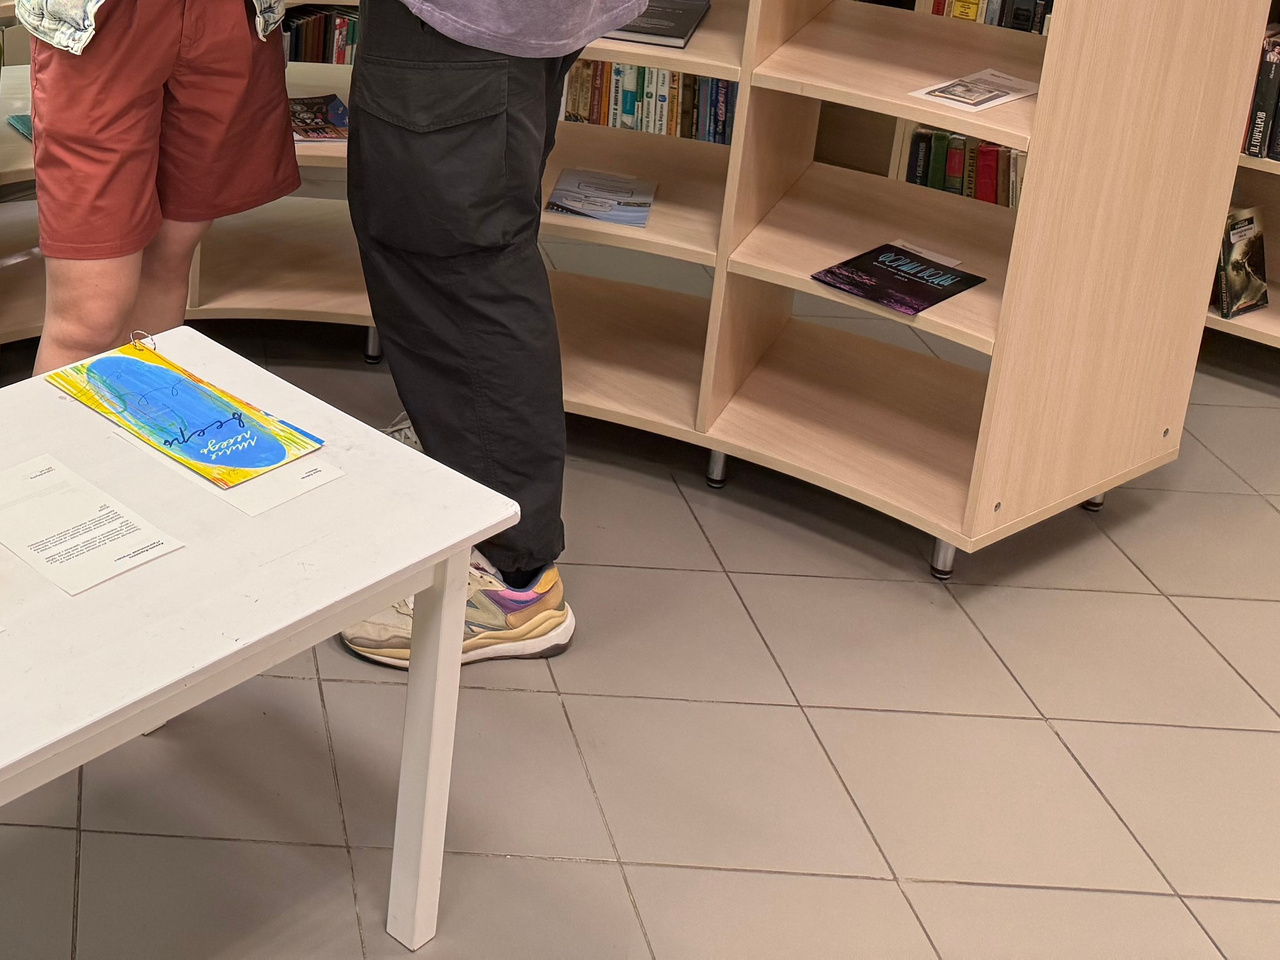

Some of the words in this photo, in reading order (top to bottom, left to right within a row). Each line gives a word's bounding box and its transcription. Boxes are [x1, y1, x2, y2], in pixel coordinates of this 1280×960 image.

[1251, 110, 1267, 146] ГОНЧАРОВ
[878, 252, 921, 274] ФОРМА
[918, 265, 961, 287] ВОДЫ
